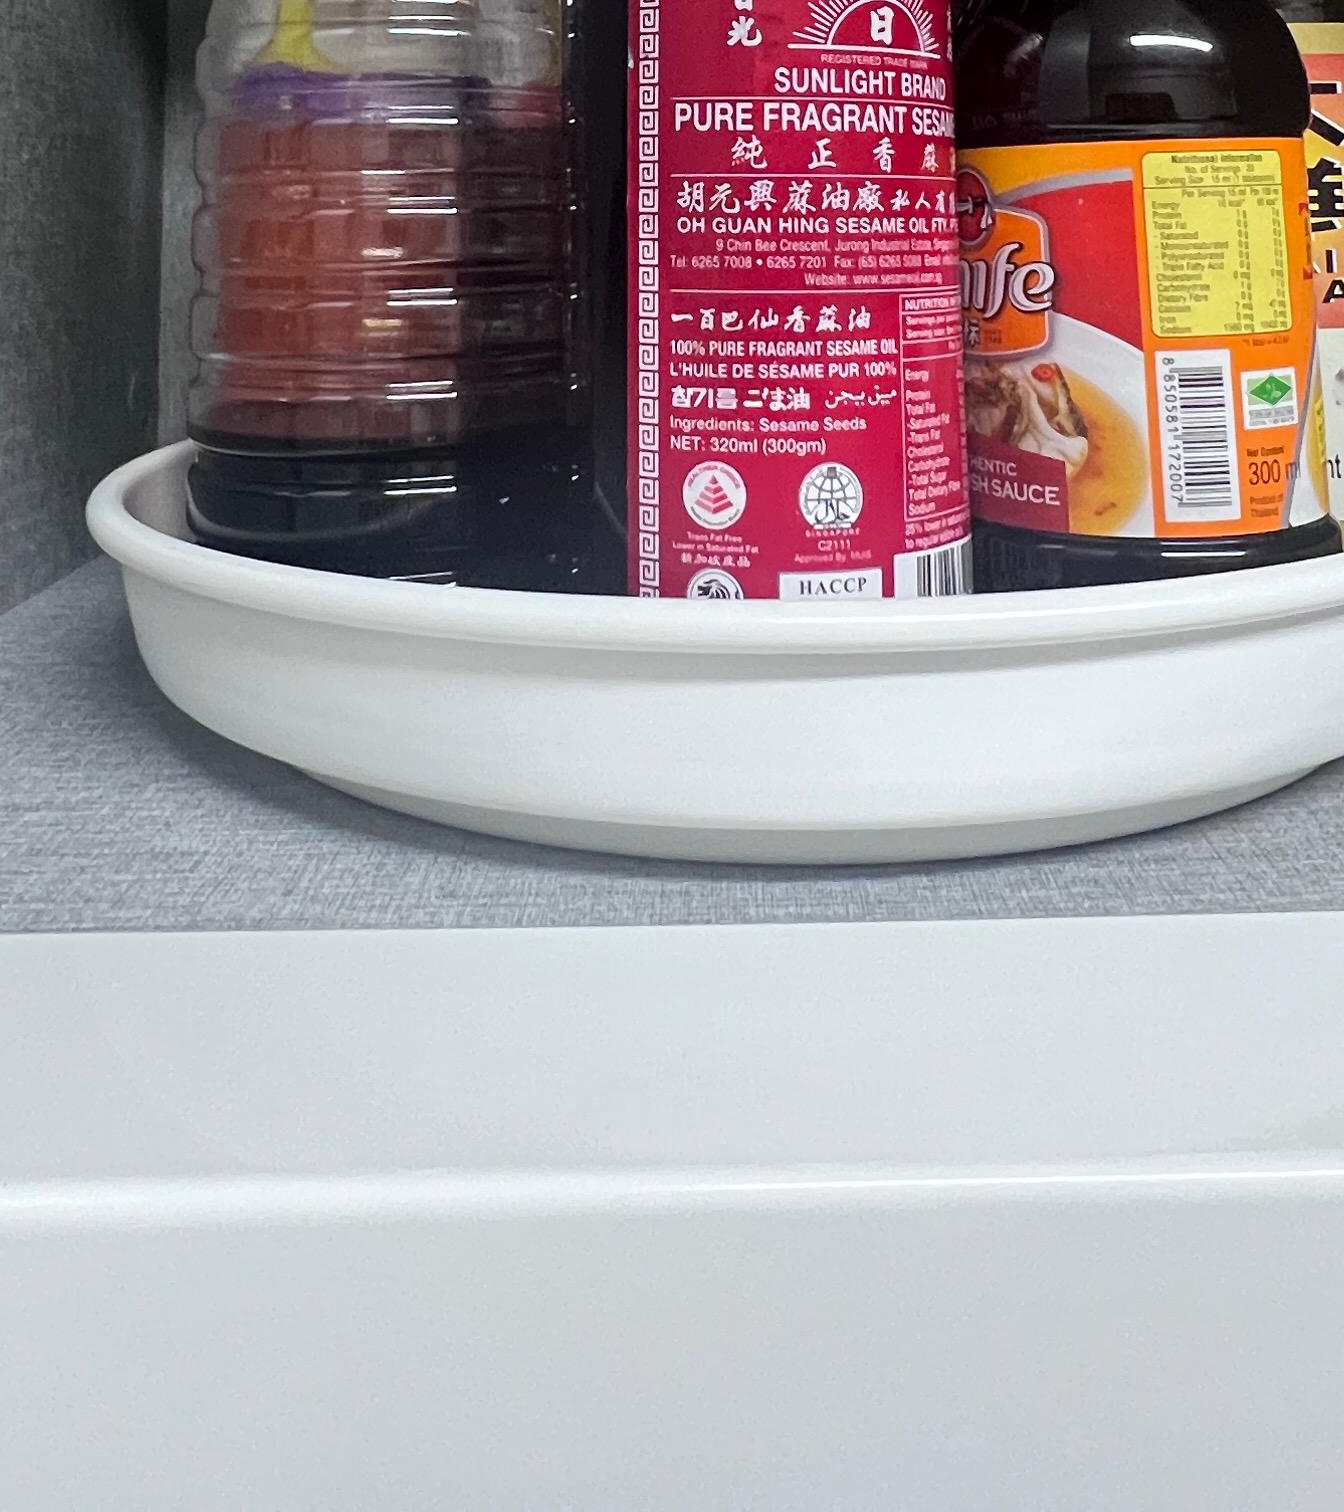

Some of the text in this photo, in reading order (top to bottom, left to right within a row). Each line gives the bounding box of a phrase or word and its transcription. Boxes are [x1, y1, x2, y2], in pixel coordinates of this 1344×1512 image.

[869, 5, 895, 45] 日
[820, 53, 882, 66] REGISTERED
[774, 67, 946, 101] SUNLIGHT BRAND
[674, 102, 754, 132] PURE
[763, 102, 908, 134] FRAGRANT
[676, 216, 706, 234] OH
[711, 216, 772, 235] GUAN
[778, 216, 831, 235] HING
[835, 216, 907, 235] SESAME
[908, 216, 929, 235] OIL
[716, 238, 724, 252] 9
[726, 238, 752, 252] Chin
[755, 238, 777, 252] Bee
[834, 239, 870, 254] Jurong
[691, 255, 721, 269] 6265
[723, 255, 753, 269] 7008
[766, 255, 796, 269] 6265
[799, 255, 827, 269] 7201
[670, 338, 899, 357] 100% PURE FRAGRANT SESAME OIL
[669, 359, 897, 380] L'HUILE DE SÉSAME PUR 100%
[669, 414, 868, 433] Ingredients: Sesame Seeds
[669, 434, 827, 457] NET: 320ml (300gm)
[969, 454, 1017, 477] HENTIC
[1248, 458, 1281, 486] 300
[991, 478, 1061, 507] SAUCE
[798, 576, 868, 596] HACCP
